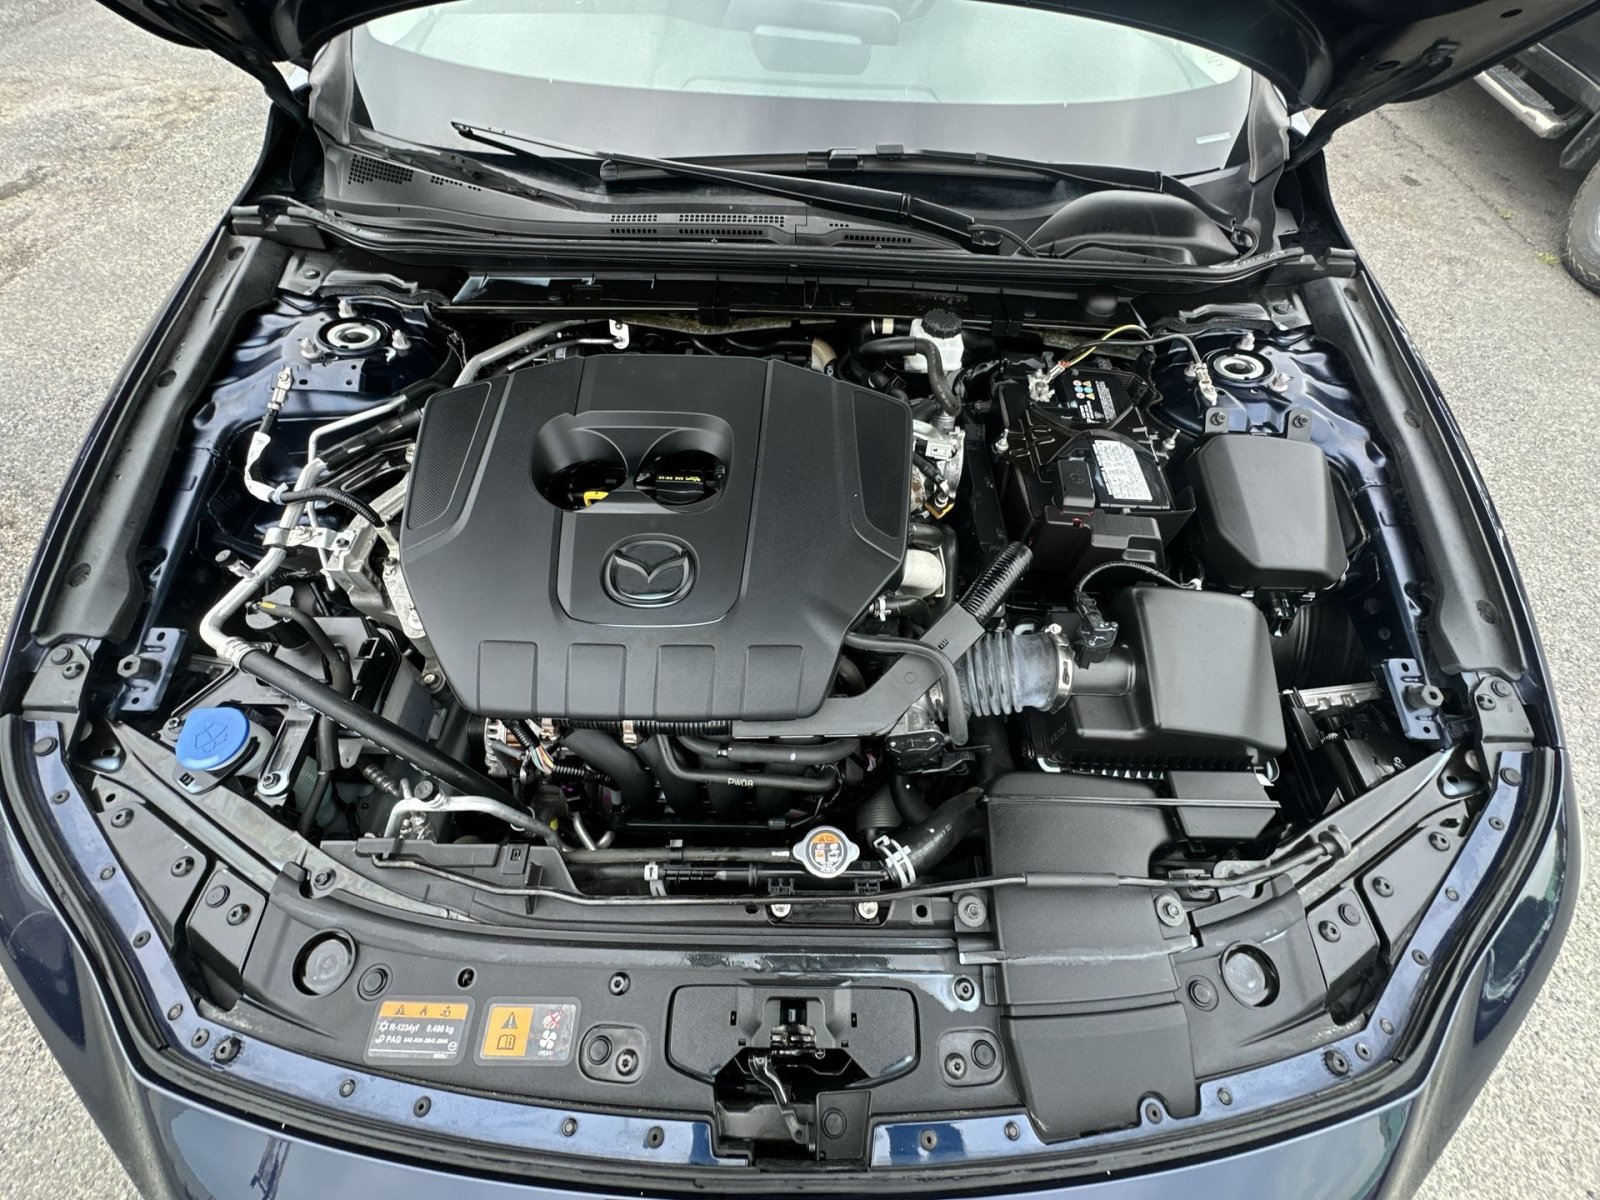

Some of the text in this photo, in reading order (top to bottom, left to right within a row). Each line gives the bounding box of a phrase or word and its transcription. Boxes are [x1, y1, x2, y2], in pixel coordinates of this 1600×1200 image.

[727, 777, 754, 787] PW08
[389, 1023, 420, 1033] R-1234yf
[445, 1025, 455, 1035] kg
[385, 1034, 402, 1044] PAG
